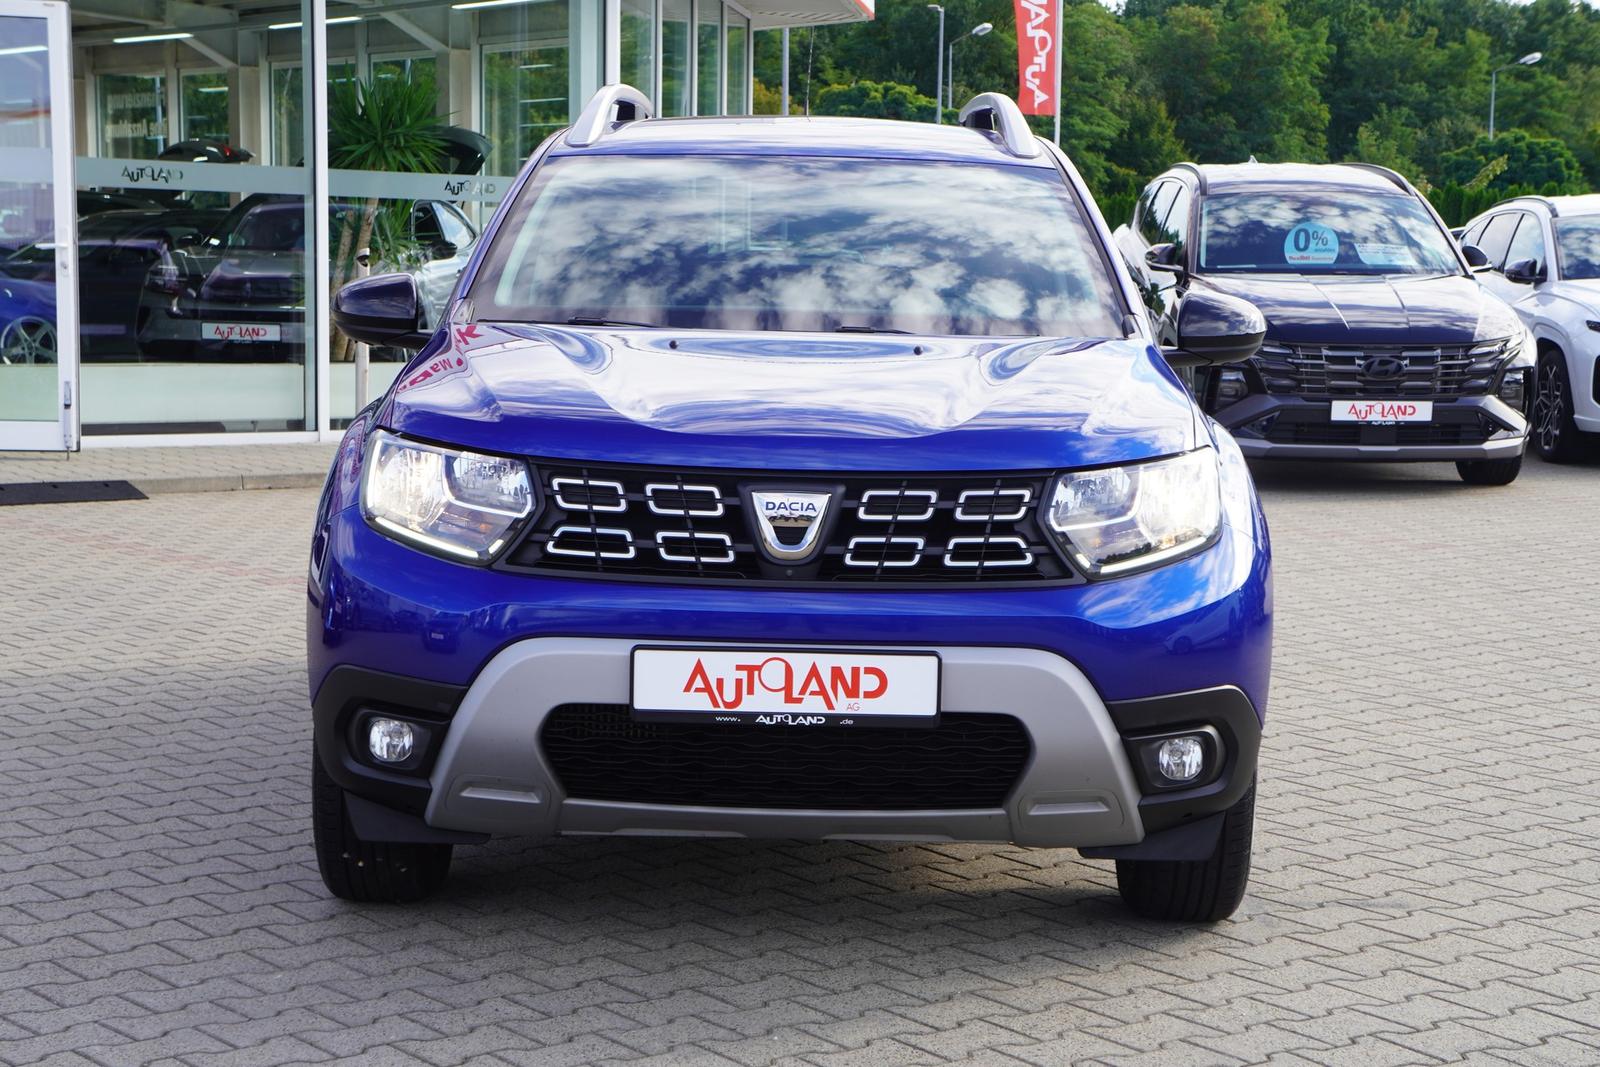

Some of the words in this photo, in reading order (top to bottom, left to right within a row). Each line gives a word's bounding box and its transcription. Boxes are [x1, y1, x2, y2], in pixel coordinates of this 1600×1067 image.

[444, 180, 496, 196] AUTOAND
[1293, 228, 1329, 252] 0%
[214, 325, 268, 341] AUTOLAND
[1348, 402, 1416, 419] AUTOLAND
[765, 501, 817, 512] DACIA
[683, 657, 888, 711] AUTOLAND
[846, 703, 860, 711] AG
[755, 713, 826, 726] AUTOLAND
